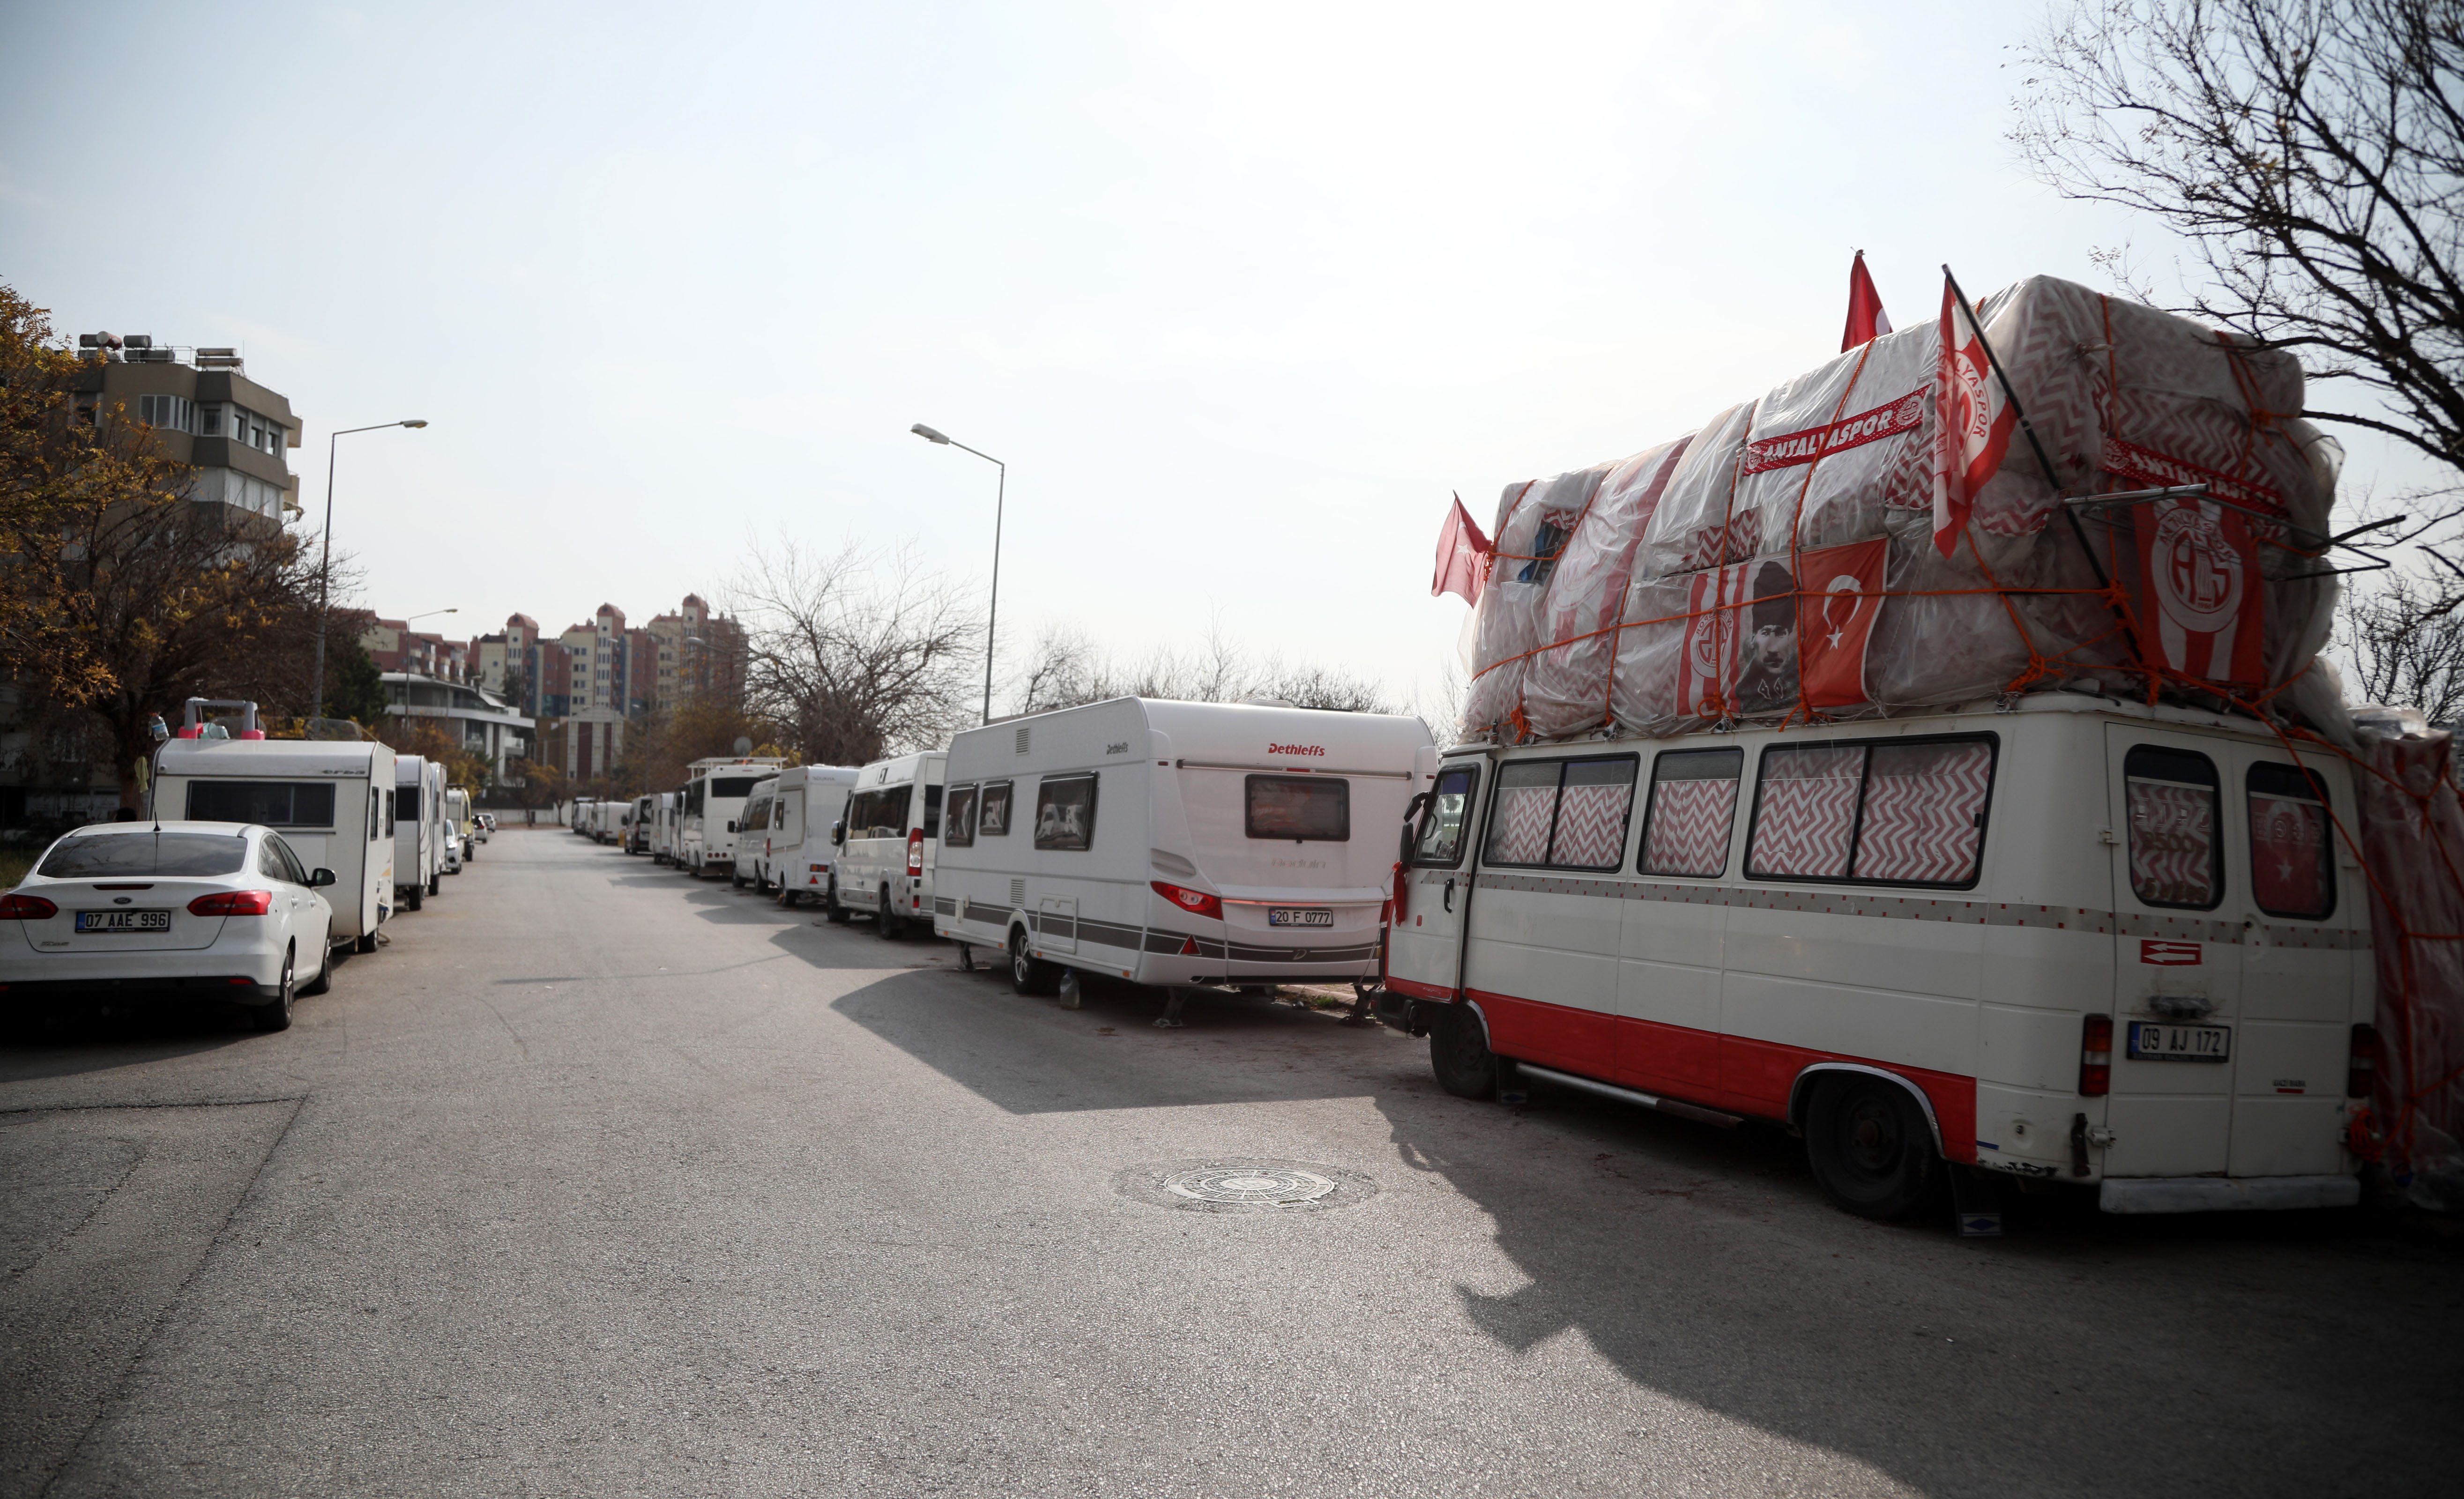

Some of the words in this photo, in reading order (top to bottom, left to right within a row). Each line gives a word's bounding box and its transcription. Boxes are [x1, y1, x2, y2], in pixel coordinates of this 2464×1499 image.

[1106, 742, 1128, 755] Dethleffs
[1268, 743, 1325, 756] Dethleffs
[86, 914, 103, 927] 07
[108, 914, 133, 927] AAE
[141, 913, 166, 927] 996
[1276, 911, 1288, 922] 20
[1294, 912, 1301, 922] F
[1305, 912, 1330, 923] 0777
[2143, 1028, 2160, 1050] 09
[2169, 1029, 2188, 1051] AJ
[2197, 1031, 2220, 1053] 172
